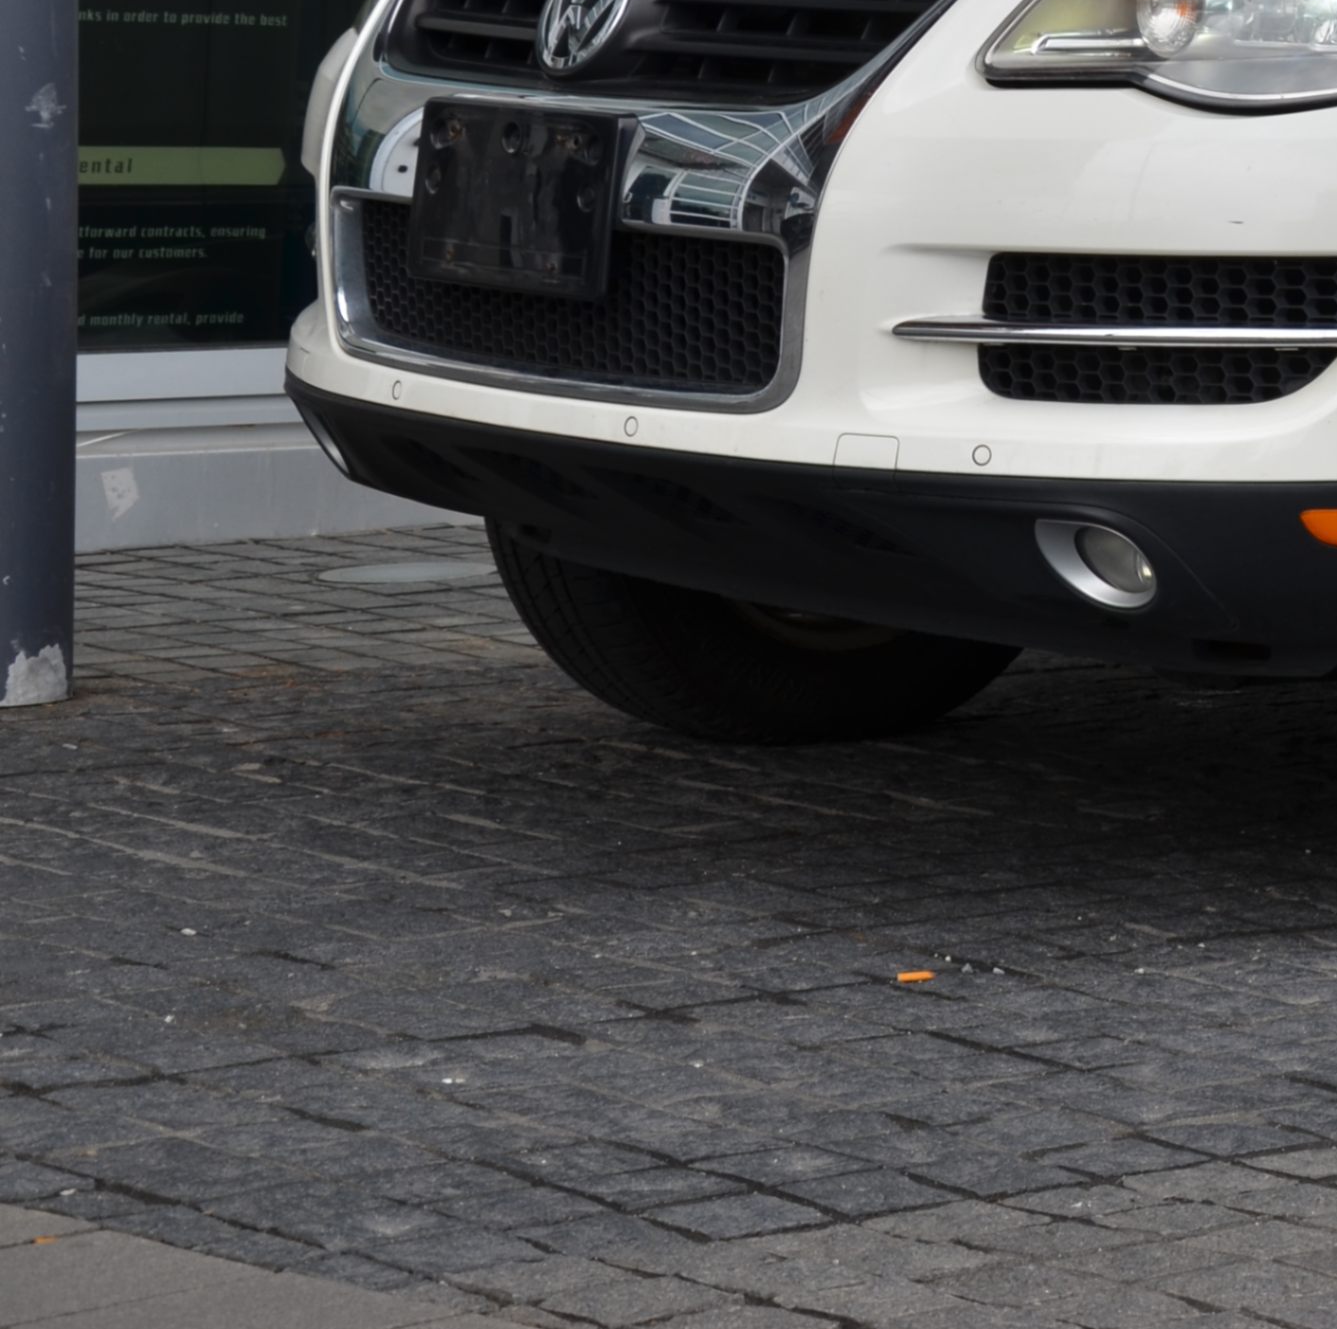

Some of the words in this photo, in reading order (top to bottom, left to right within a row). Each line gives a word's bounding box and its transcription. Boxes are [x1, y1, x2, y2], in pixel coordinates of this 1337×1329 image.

[123, 9, 159, 23] order
[163, 11, 177, 24] to
[181, 12, 230, 30] provide
[234, 12, 256, 26] the
[259, 13, 288, 27] best
[209, 225, 267, 240] ensuring
[88, 246, 109, 260] for
[112, 248, 135, 260] our
[90, 311, 144, 327] monthly
[194, 312, 246, 327] provide
